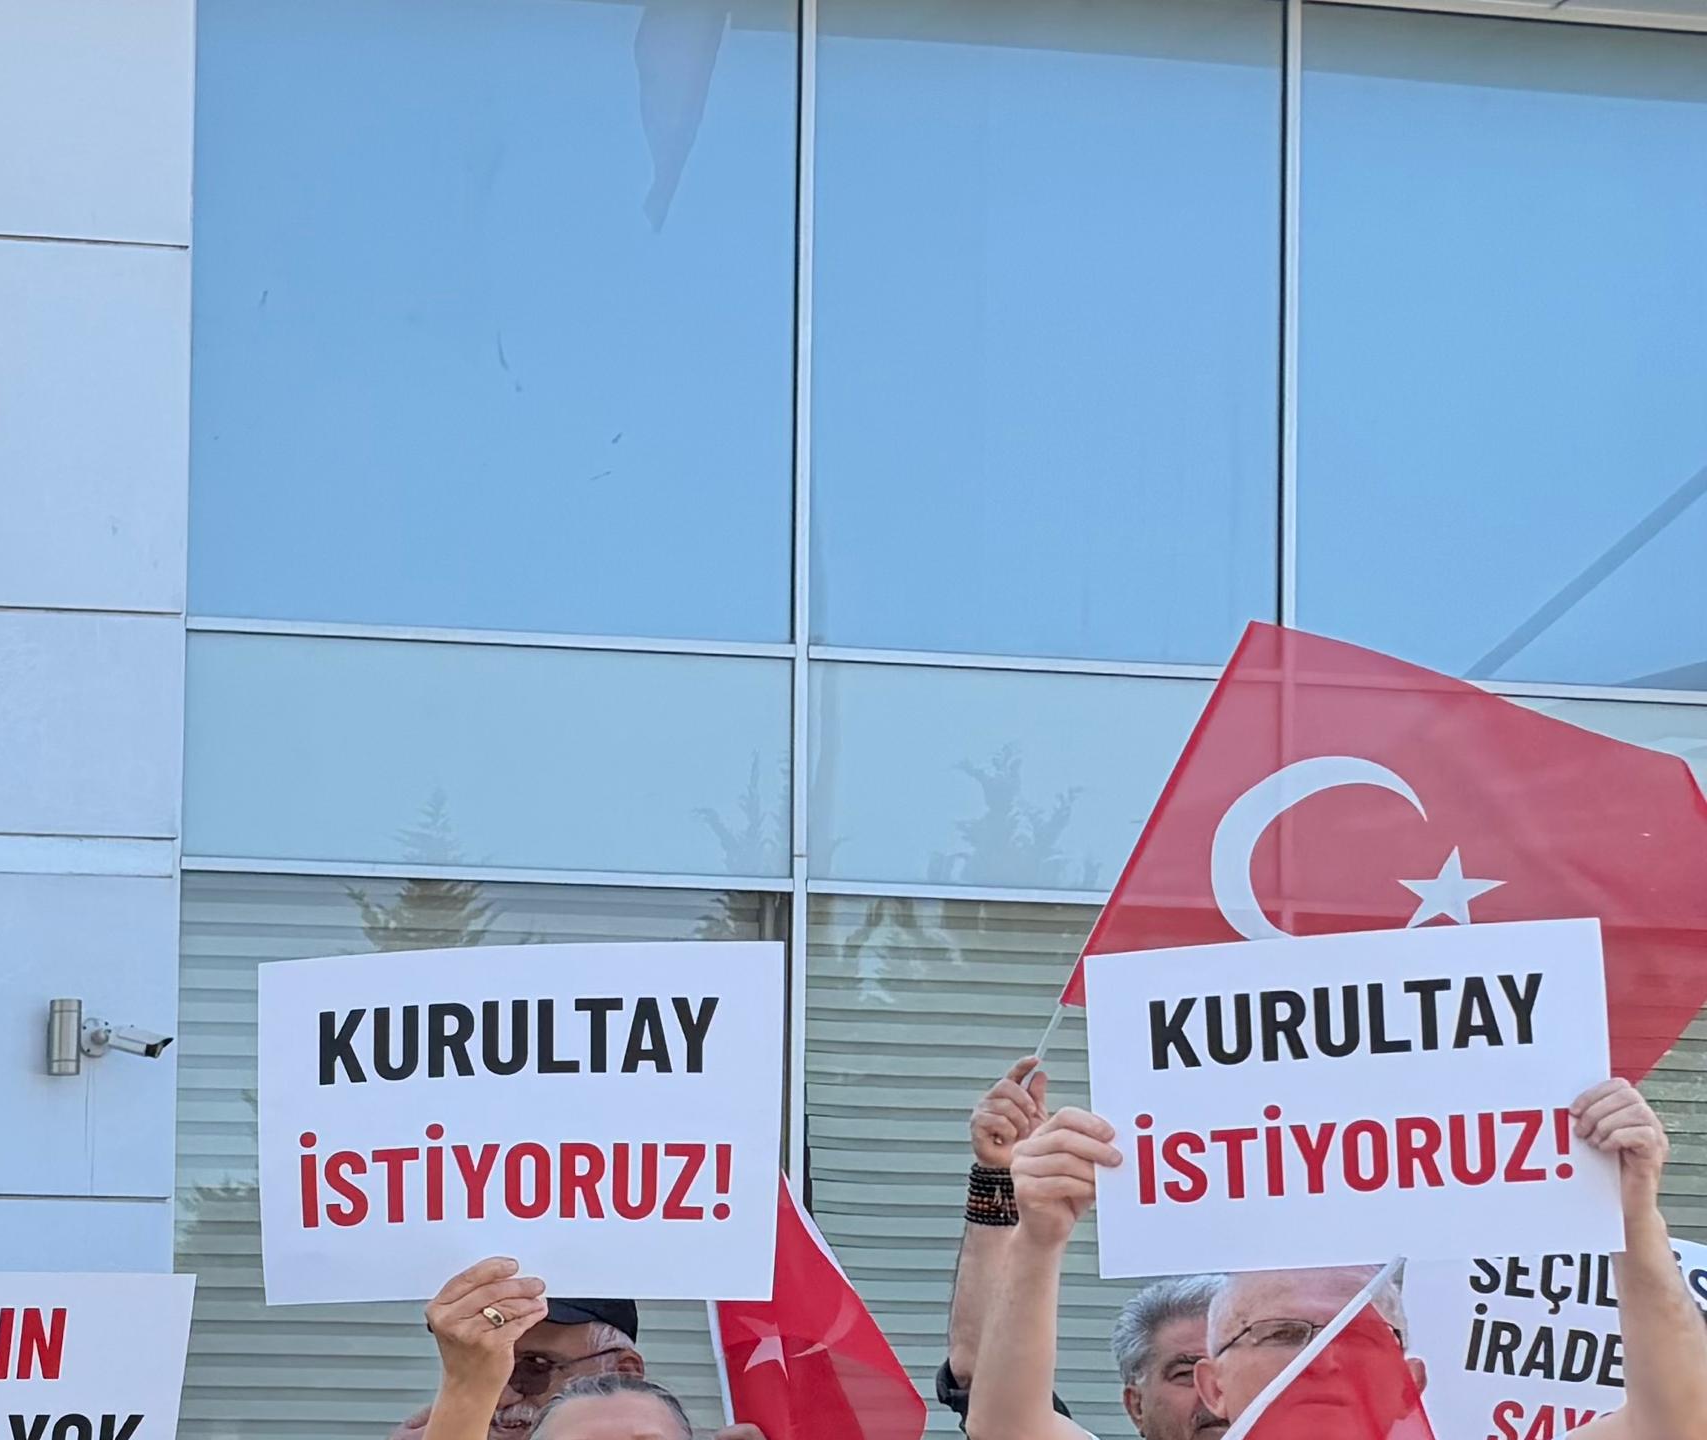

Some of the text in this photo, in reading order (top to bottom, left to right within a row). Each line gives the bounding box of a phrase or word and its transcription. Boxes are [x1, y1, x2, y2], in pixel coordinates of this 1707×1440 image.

[320, 997, 719, 1085] KURULTAY
[1150, 973, 1542, 1070] KURULTAY
[300, 1124, 731, 1228] İSTİYORUZ!
[1135, 1105, 1576, 1204] İSTİYORUZ!
